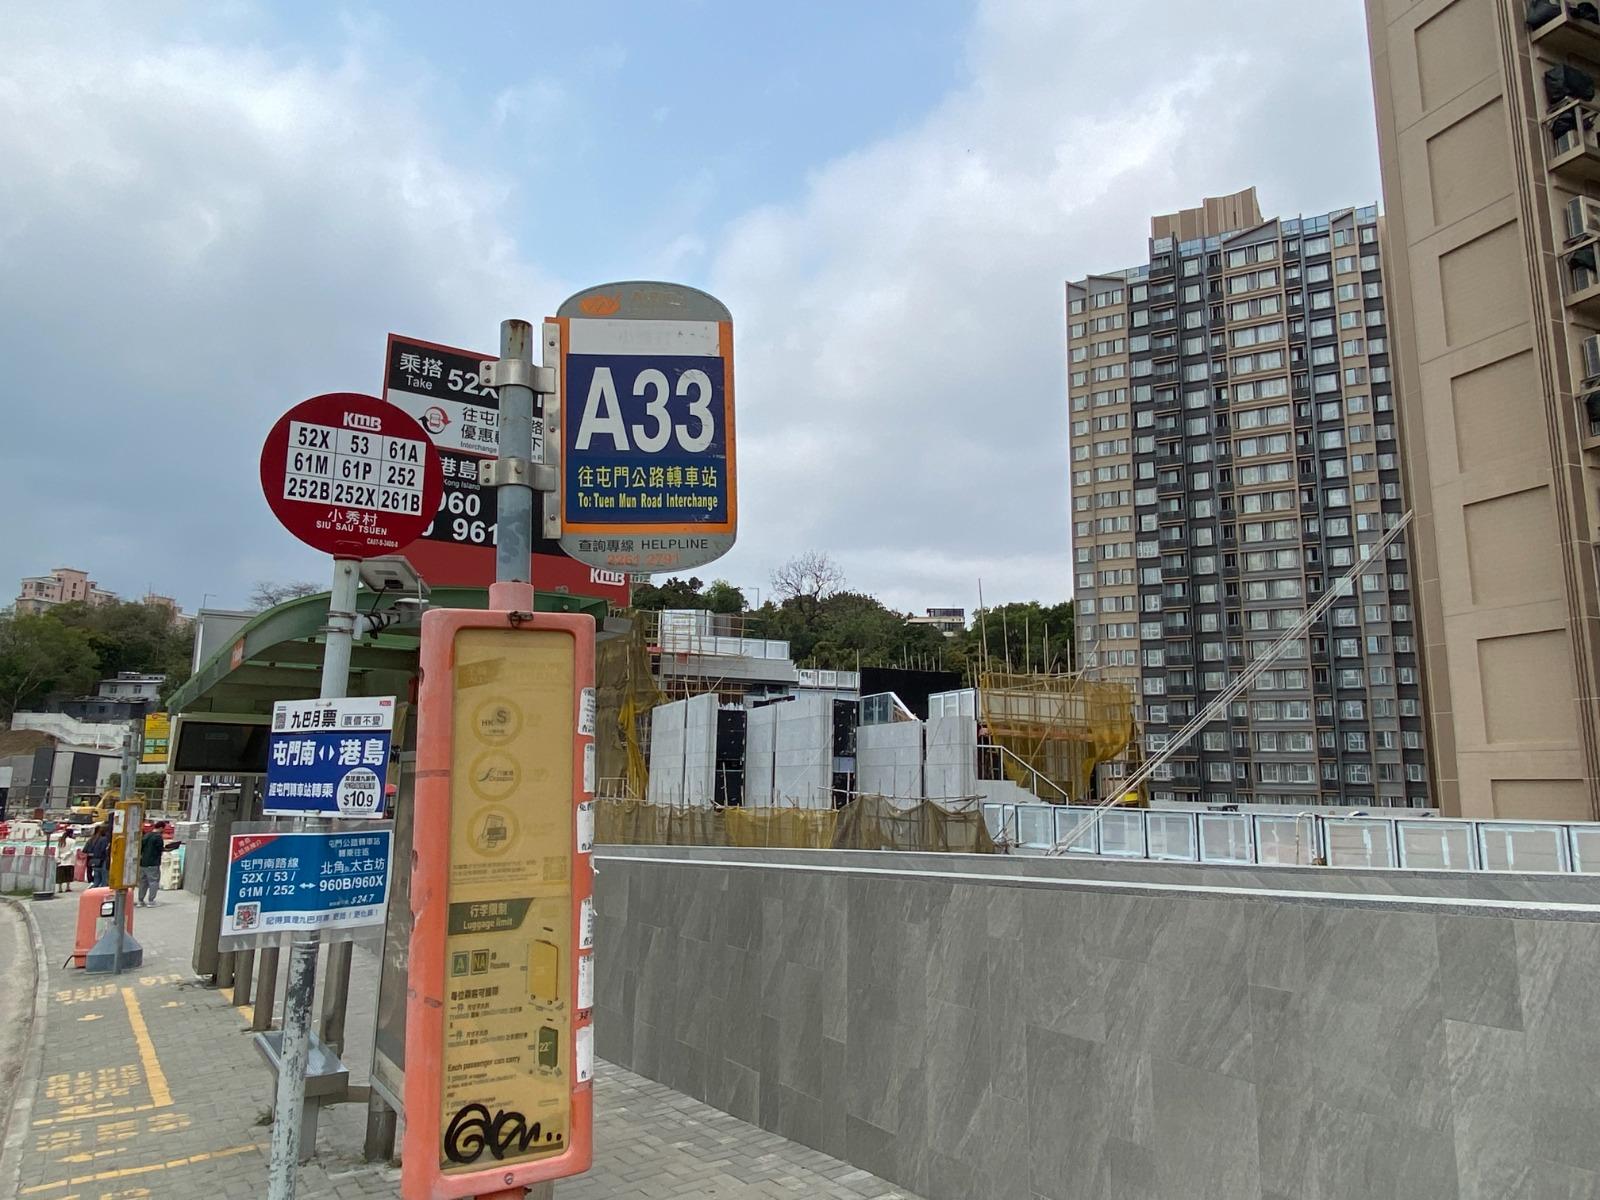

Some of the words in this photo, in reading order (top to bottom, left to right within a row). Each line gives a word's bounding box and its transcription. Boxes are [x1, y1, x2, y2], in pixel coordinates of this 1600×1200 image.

[400, 352, 444, 379] 乘搭
[406, 374, 433, 391] Take
[574, 366, 715, 453] A33
[298, 426, 330, 449] 52X
[350, 434, 369, 455] 53
[389, 441, 418, 463] 61A
[294, 452, 328, 475] 61M
[342, 459, 372, 480] 61P
[387, 466, 416, 487] 252
[577, 466, 717, 488] 往屯門公路轉車站
[288, 477, 330, 500] 252B
[334, 484, 376, 507] 252X
[381, 490, 420, 512] 261B
[578, 492, 592, 508] To:
[593, 492, 615, 508] Tuen
[619, 493, 637, 508] Mun
[641, 493, 662, 508] Road
[666, 493, 718, 511] Interchange
[327, 508, 378, 527] 小秀村
[316, 520, 331, 530] SIU
[335, 522, 354, 532] SAU
[358, 525, 388, 536] TSUEN
[578, 539, 634, 552] 查詢專線
[641, 539, 709, 550] HELPLINE
[291, 709, 338, 729] 九巴月票
[273, 739, 316, 766] 屯門南
[338, 739, 385, 766] 港島
[343, 790, 373, 808] $10.9
[241, 858, 299, 871] 屯門南路線
[241, 873, 264, 884] 52X
[266, 872, 271, 882] /
[273, 871, 288, 882] 53
[291, 871, 296, 881] /
[319, 875, 384, 892] 960B/960X
[239, 886, 263, 898] 61M
[273, 885, 295, 896] 252
[351, 893, 375, 905] $24.7
[463, 920, 496, 931] Luggage
[448, 1063, 462, 1072] Each
[463, 1059, 493, 1071] passenger
[506, 1056, 520, 1064] carry
